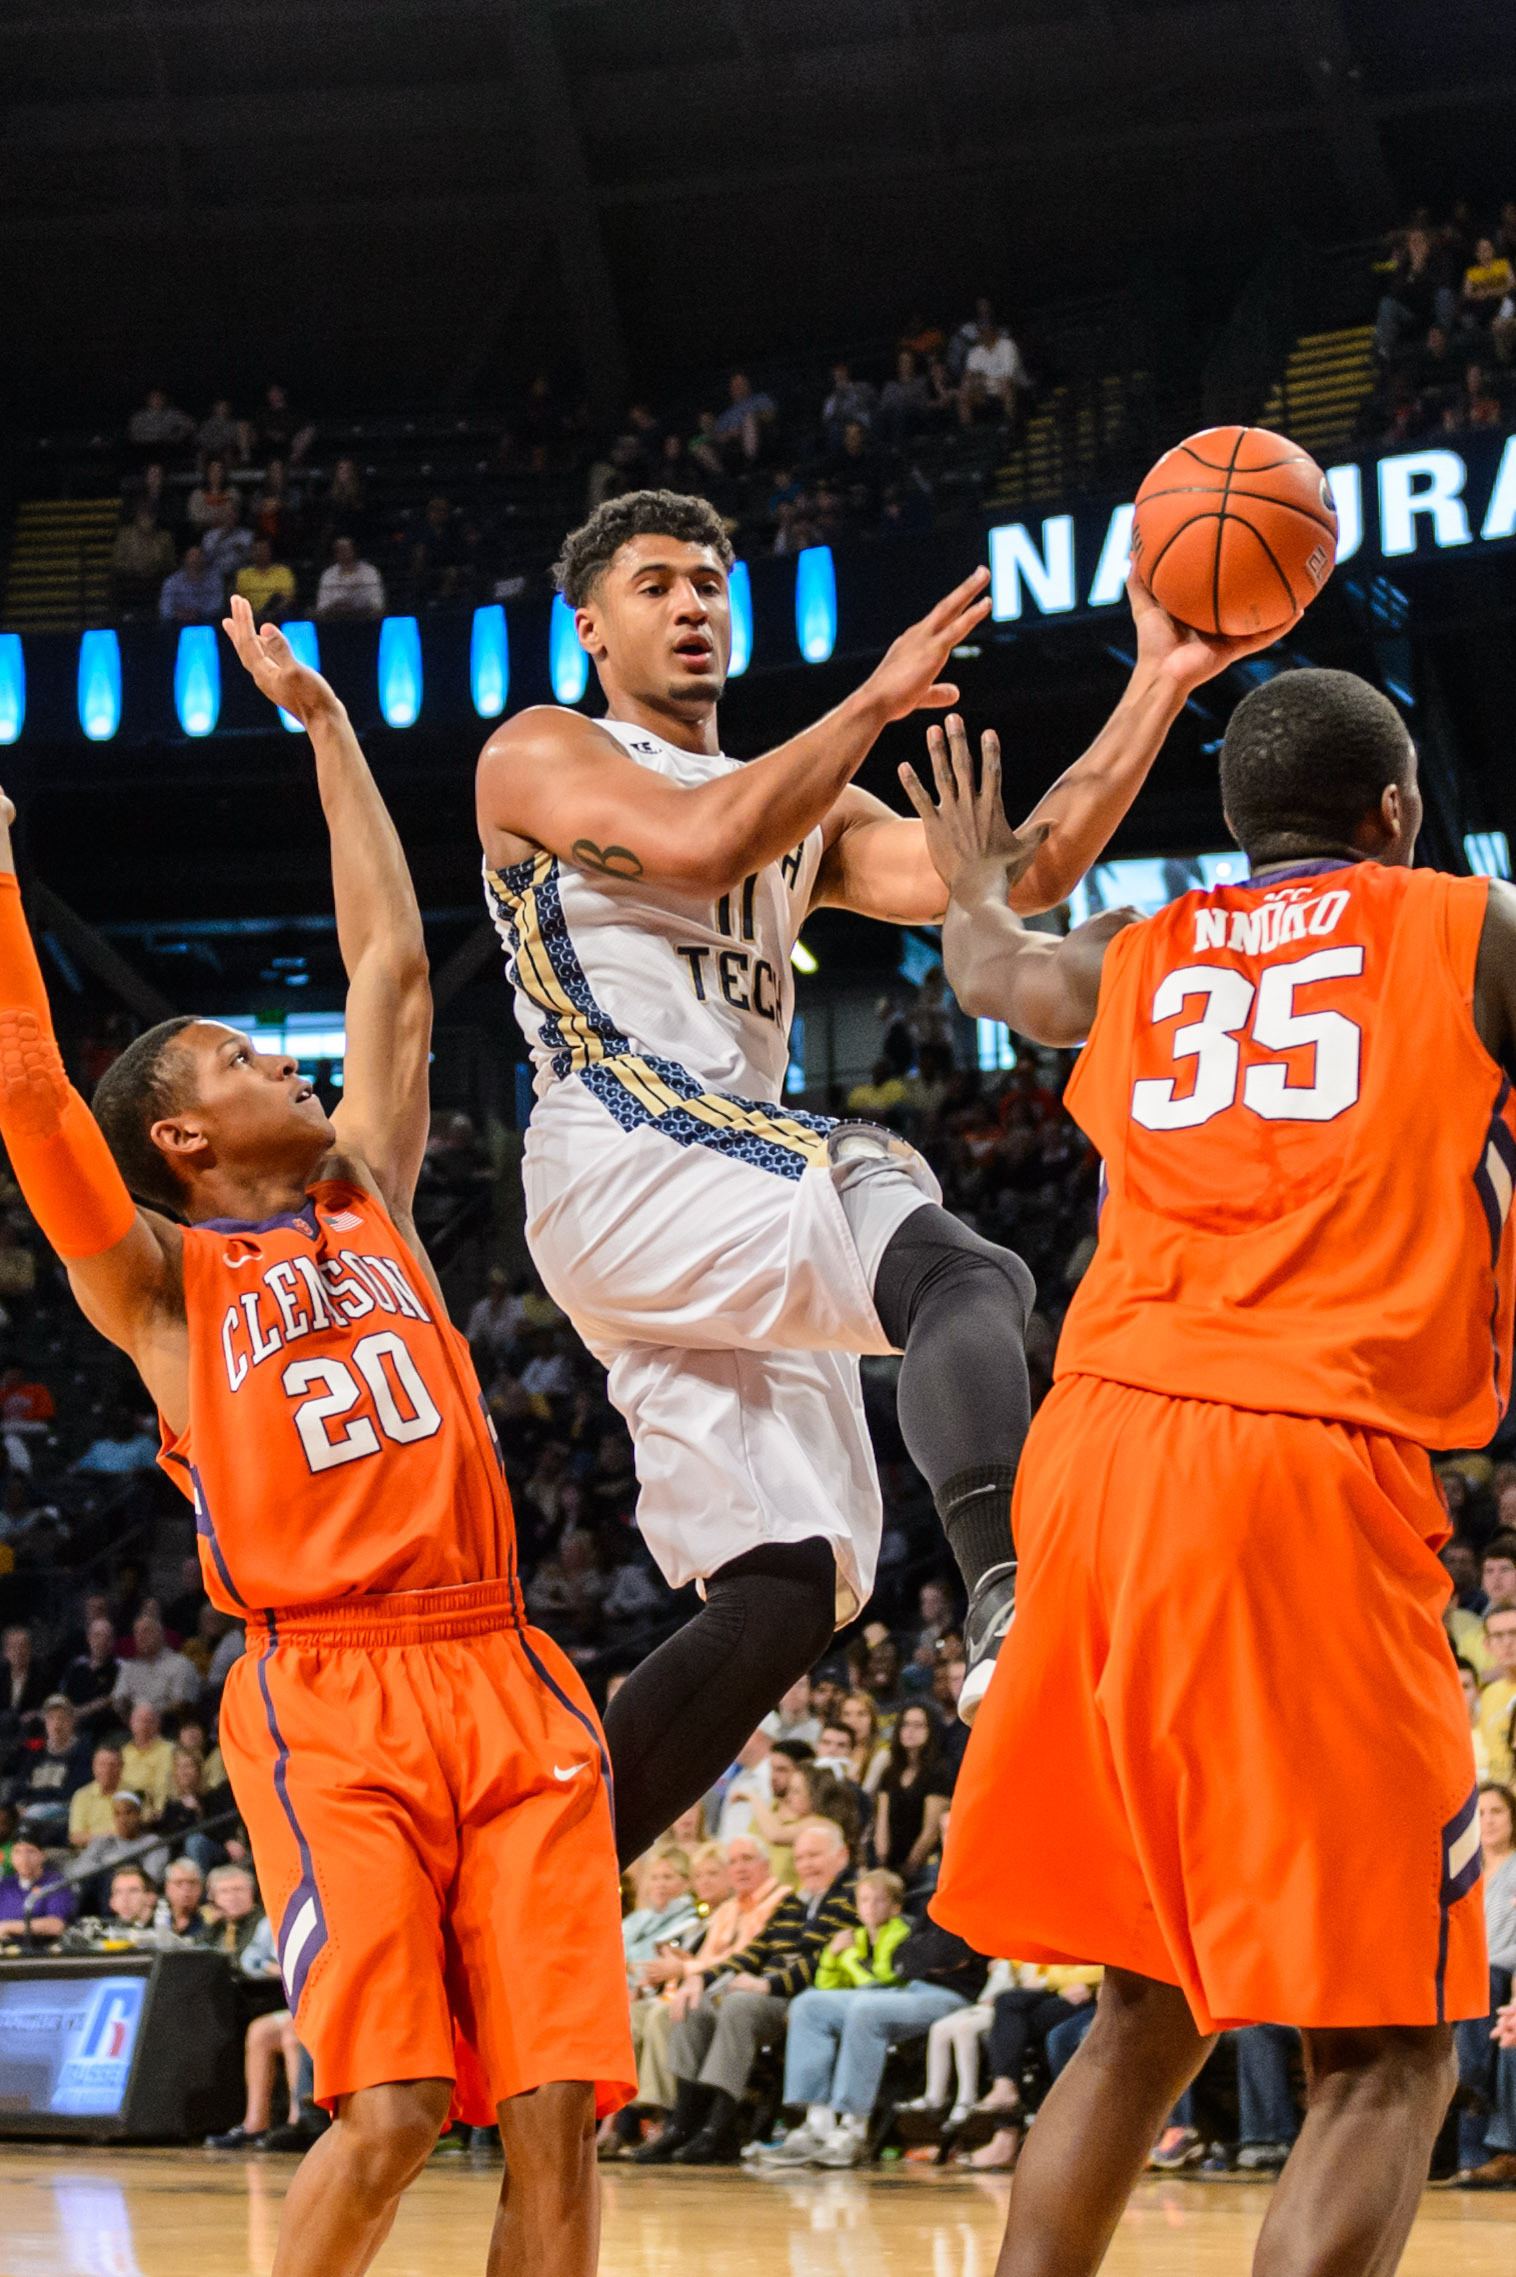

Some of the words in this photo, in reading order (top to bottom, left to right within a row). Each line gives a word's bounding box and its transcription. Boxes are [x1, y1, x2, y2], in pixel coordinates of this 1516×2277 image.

[677, 945, 782, 1028] TECH
[1131, 945, 1365, 1131] 35
[221, 1249, 434, 1393] CLEMSON
[281, 1330, 443, 1474] 20
